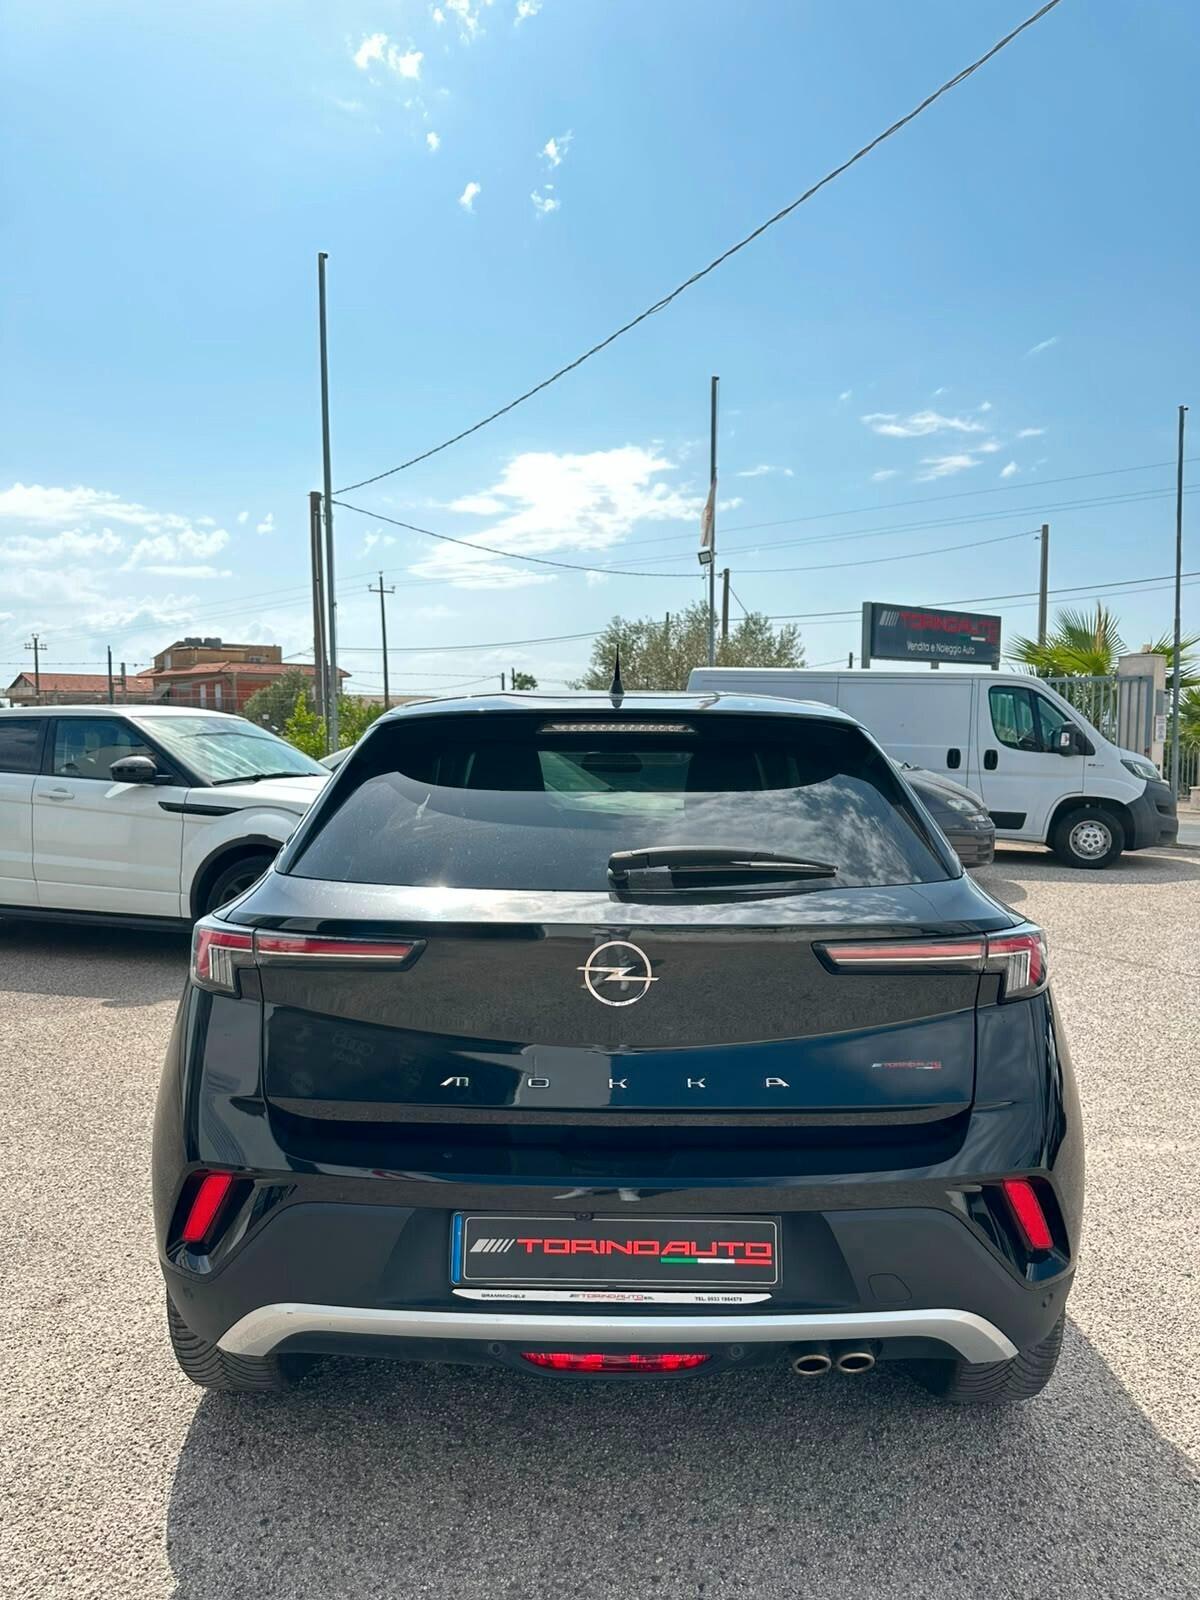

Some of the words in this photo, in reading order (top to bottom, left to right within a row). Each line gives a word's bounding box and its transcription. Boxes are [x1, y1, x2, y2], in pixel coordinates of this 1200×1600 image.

[901, 611, 999, 638] TORINOAUTO
[906, 641, 930, 652] Vendita
[936, 643, 961, 656] Noleggio
[963, 645, 976, 655] Auto
[440, 1076, 790, 1089] MOKKA
[517, 1239, 772, 1257] TORINOAUTO
